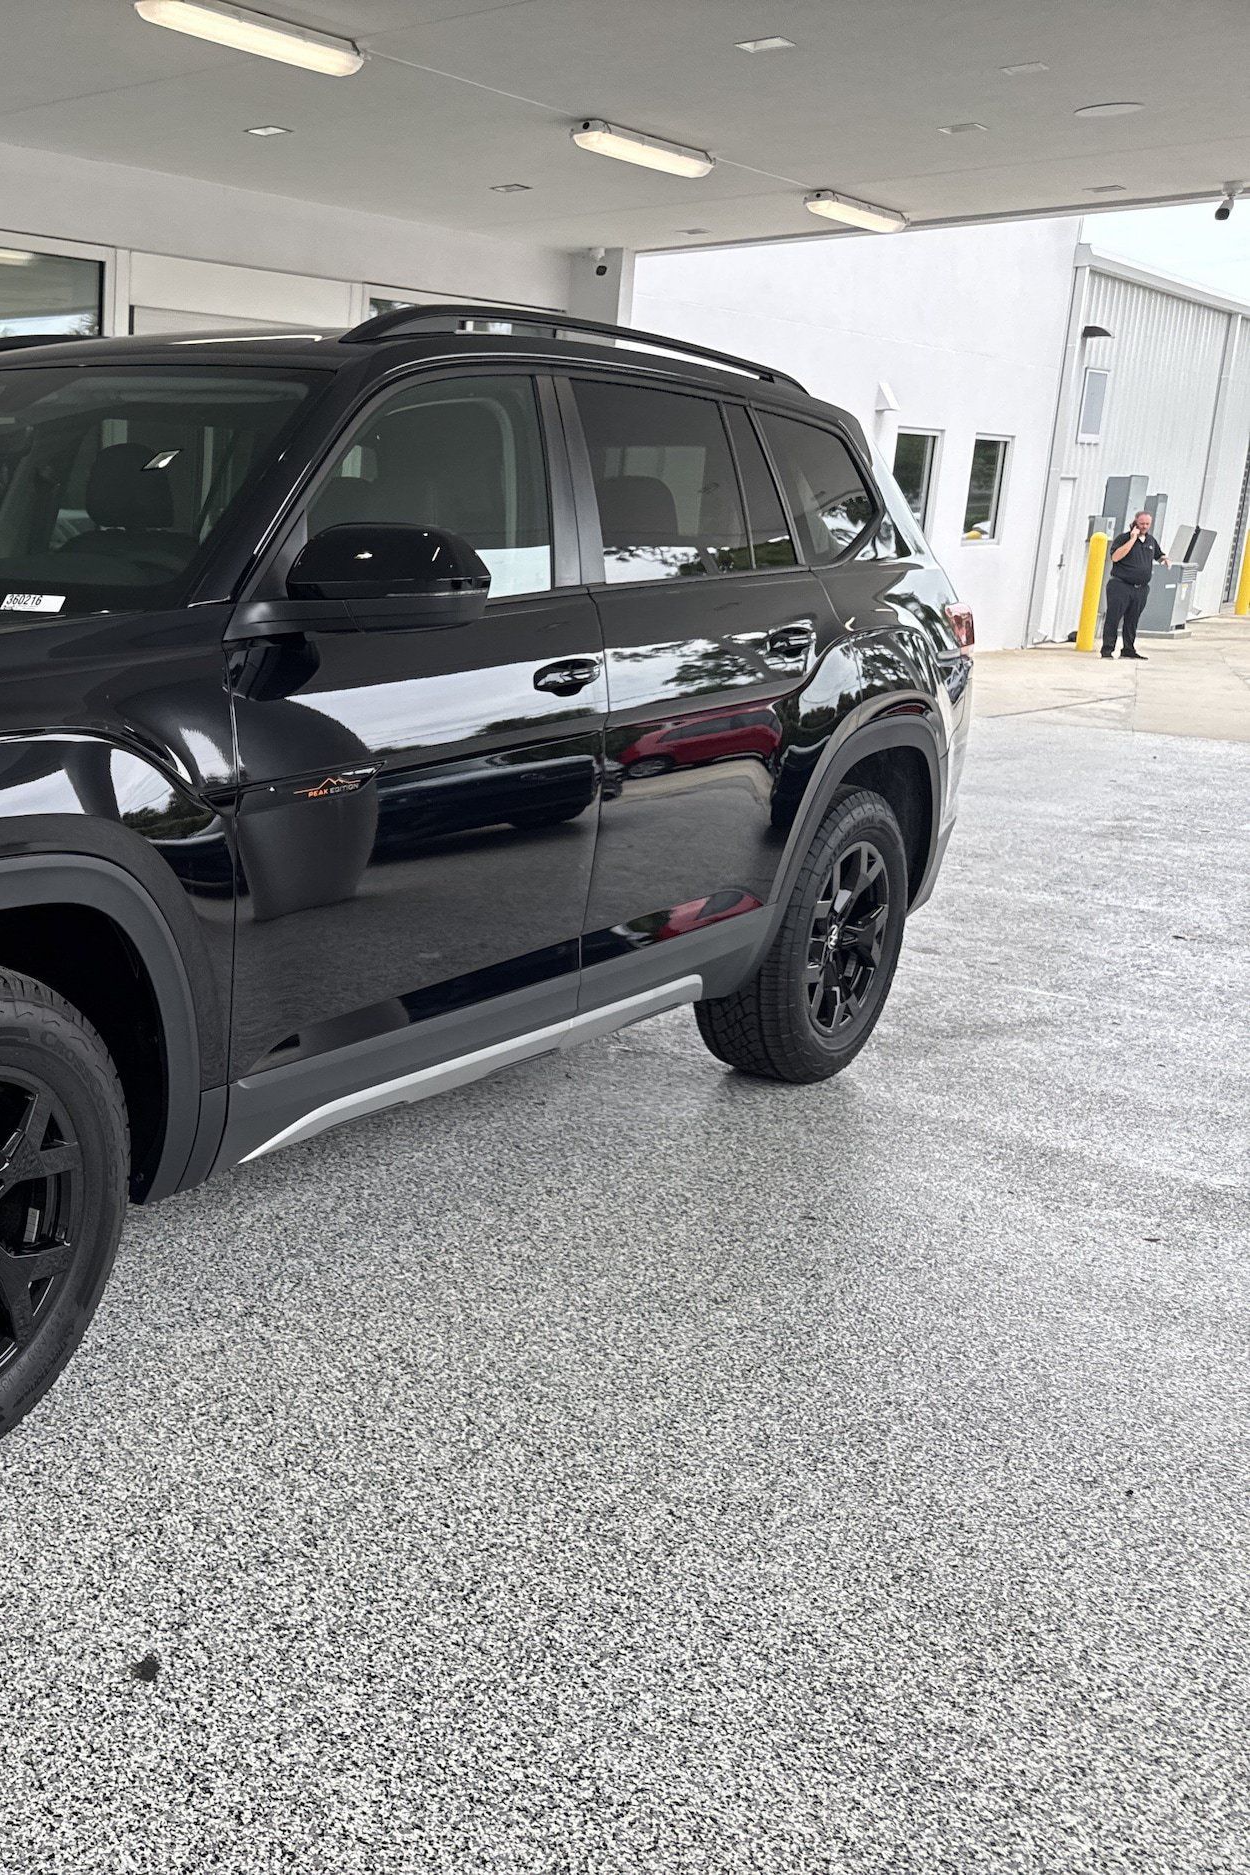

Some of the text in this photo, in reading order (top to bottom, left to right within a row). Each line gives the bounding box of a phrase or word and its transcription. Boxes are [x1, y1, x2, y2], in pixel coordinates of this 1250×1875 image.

[7, 593, 45, 606] 360216
[308, 783, 360, 798] PEAK EDITION
